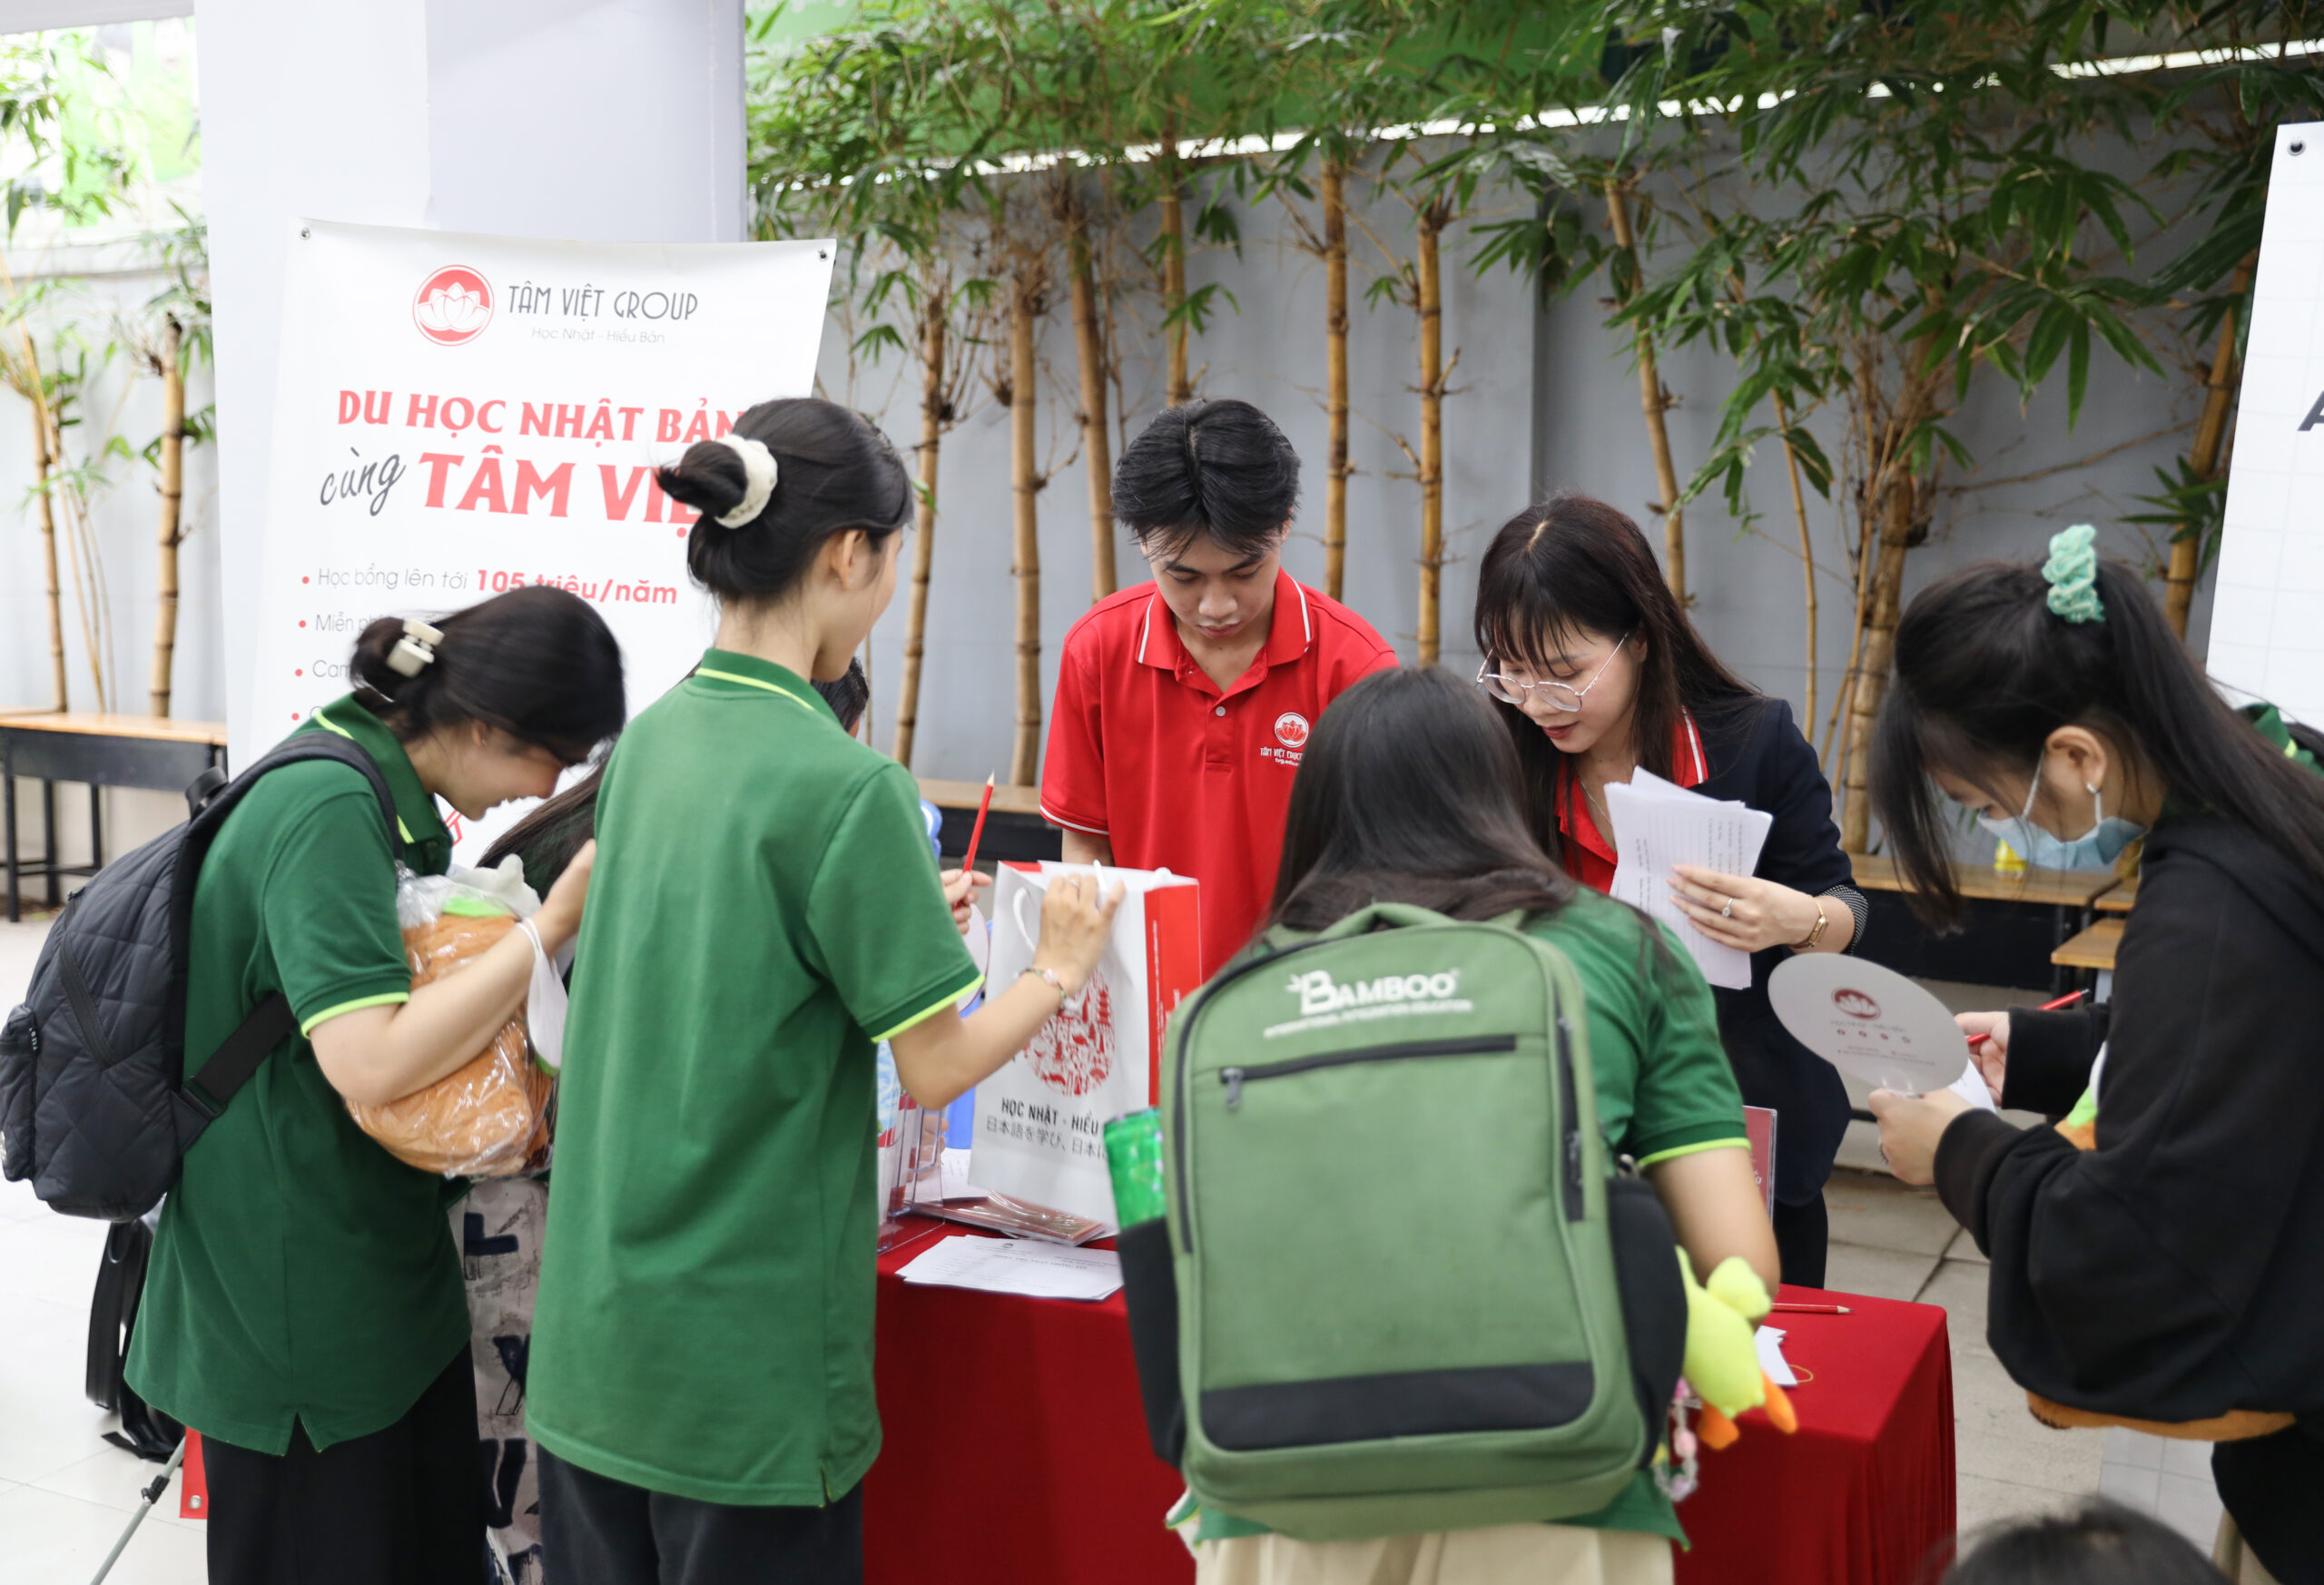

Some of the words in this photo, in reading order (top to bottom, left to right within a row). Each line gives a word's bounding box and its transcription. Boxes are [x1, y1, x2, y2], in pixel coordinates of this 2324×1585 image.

[508, 280, 552, 315] TÂM
[562, 283, 605, 321] VIỆT
[614, 290, 698, 320] GROUP
[531, 326, 559, 342] Học
[562, 328, 596, 343] Nhật
[606, 328, 635, 343] Hiểu
[639, 330, 665, 344] Bản
[338, 389, 393, 425] DU
[406, 393, 507, 438] HỌC
[518, 398, 645, 448] NHẬT
[655, 397, 746, 444] BẢN
[320, 446, 407, 517] cùng
[418, 444, 577, 518] TÂM
[318, 567, 350, 589] Học
[354, 562, 399, 590] bổng
[404, 568, 434, 588] lên
[441, 570, 468, 589] tới
[478, 568, 526, 593] 105
[315, 611, 354, 632] Miễn
[1300, 969, 1457, 1016] BAMBOO
[1001, 1097, 1025, 1118] HỌC
[1028, 1103, 1059, 1127] NHẬT
[1071, 1109, 1099, 1137] HIỂU
